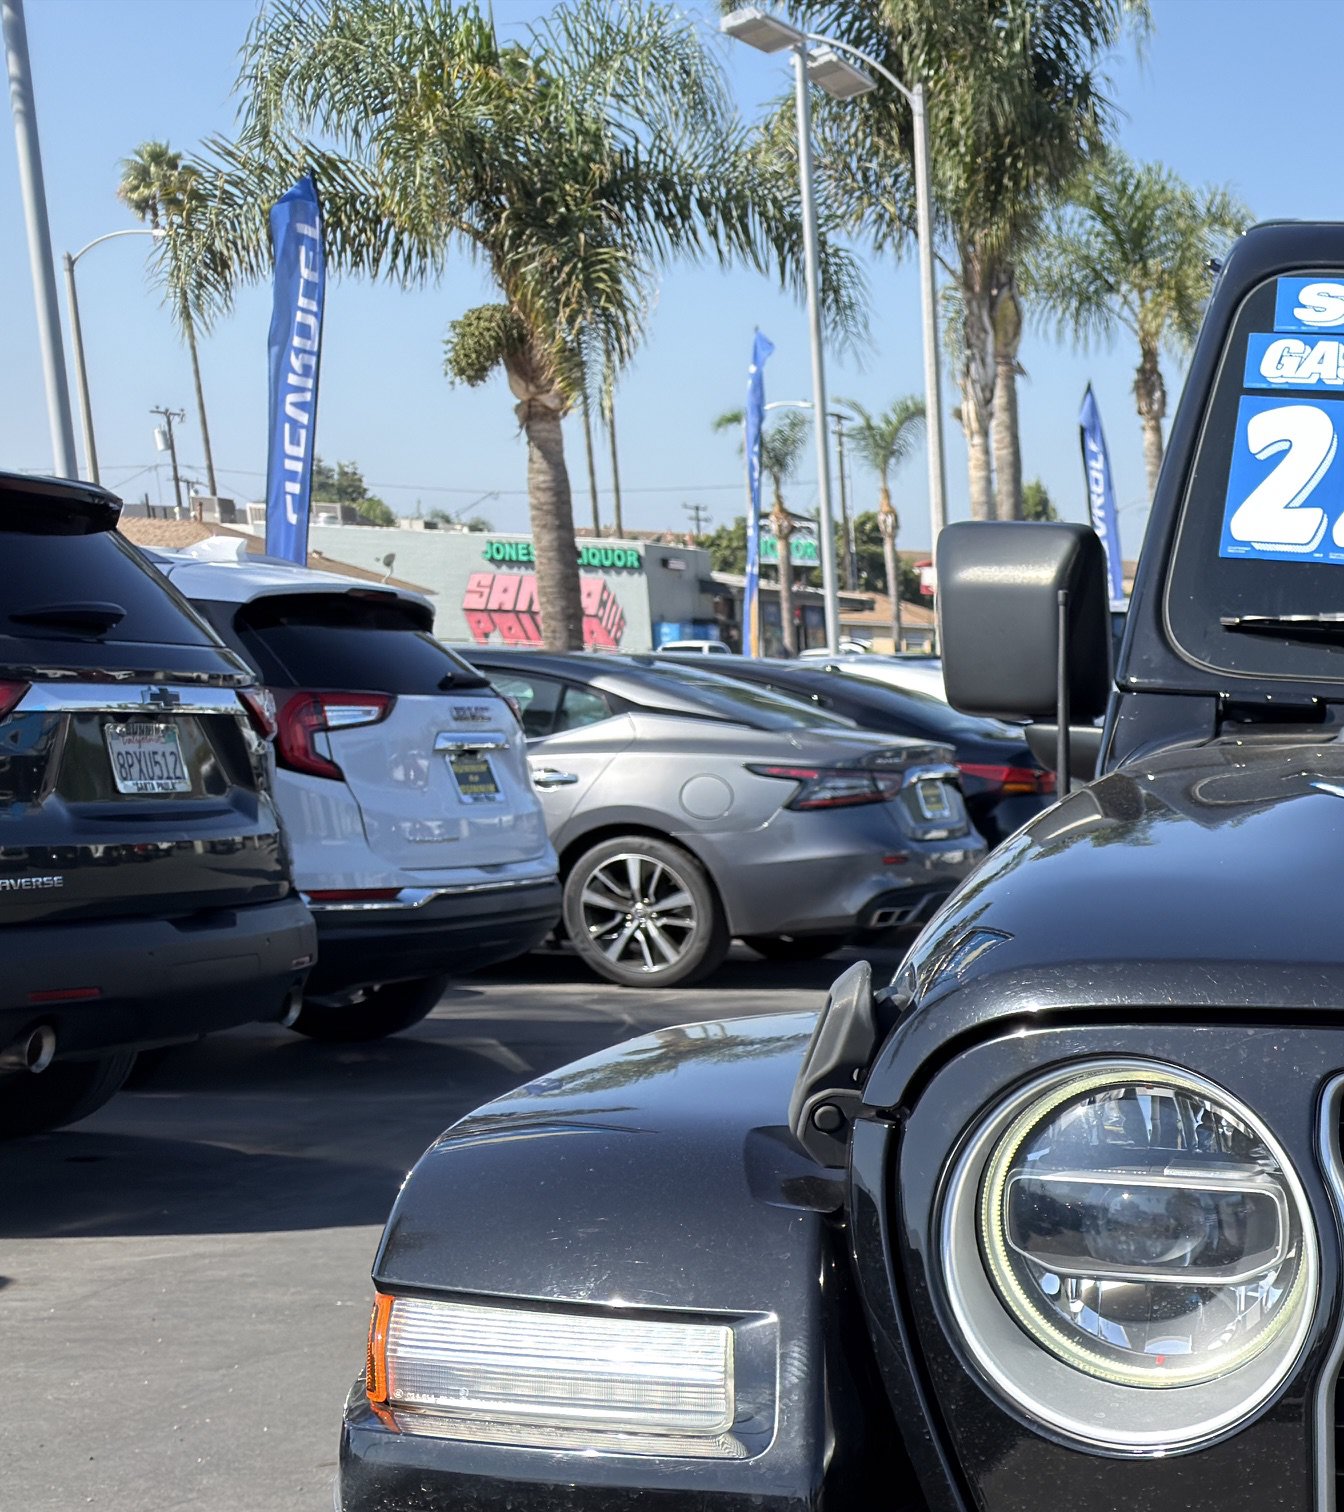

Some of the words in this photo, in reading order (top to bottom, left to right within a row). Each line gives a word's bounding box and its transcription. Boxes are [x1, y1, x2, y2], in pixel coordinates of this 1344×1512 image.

[577, 546, 640, 568] IQUOR
[116, 750, 182, 781] 8PXU512
[0, 875, 63, 891] AVERSE
